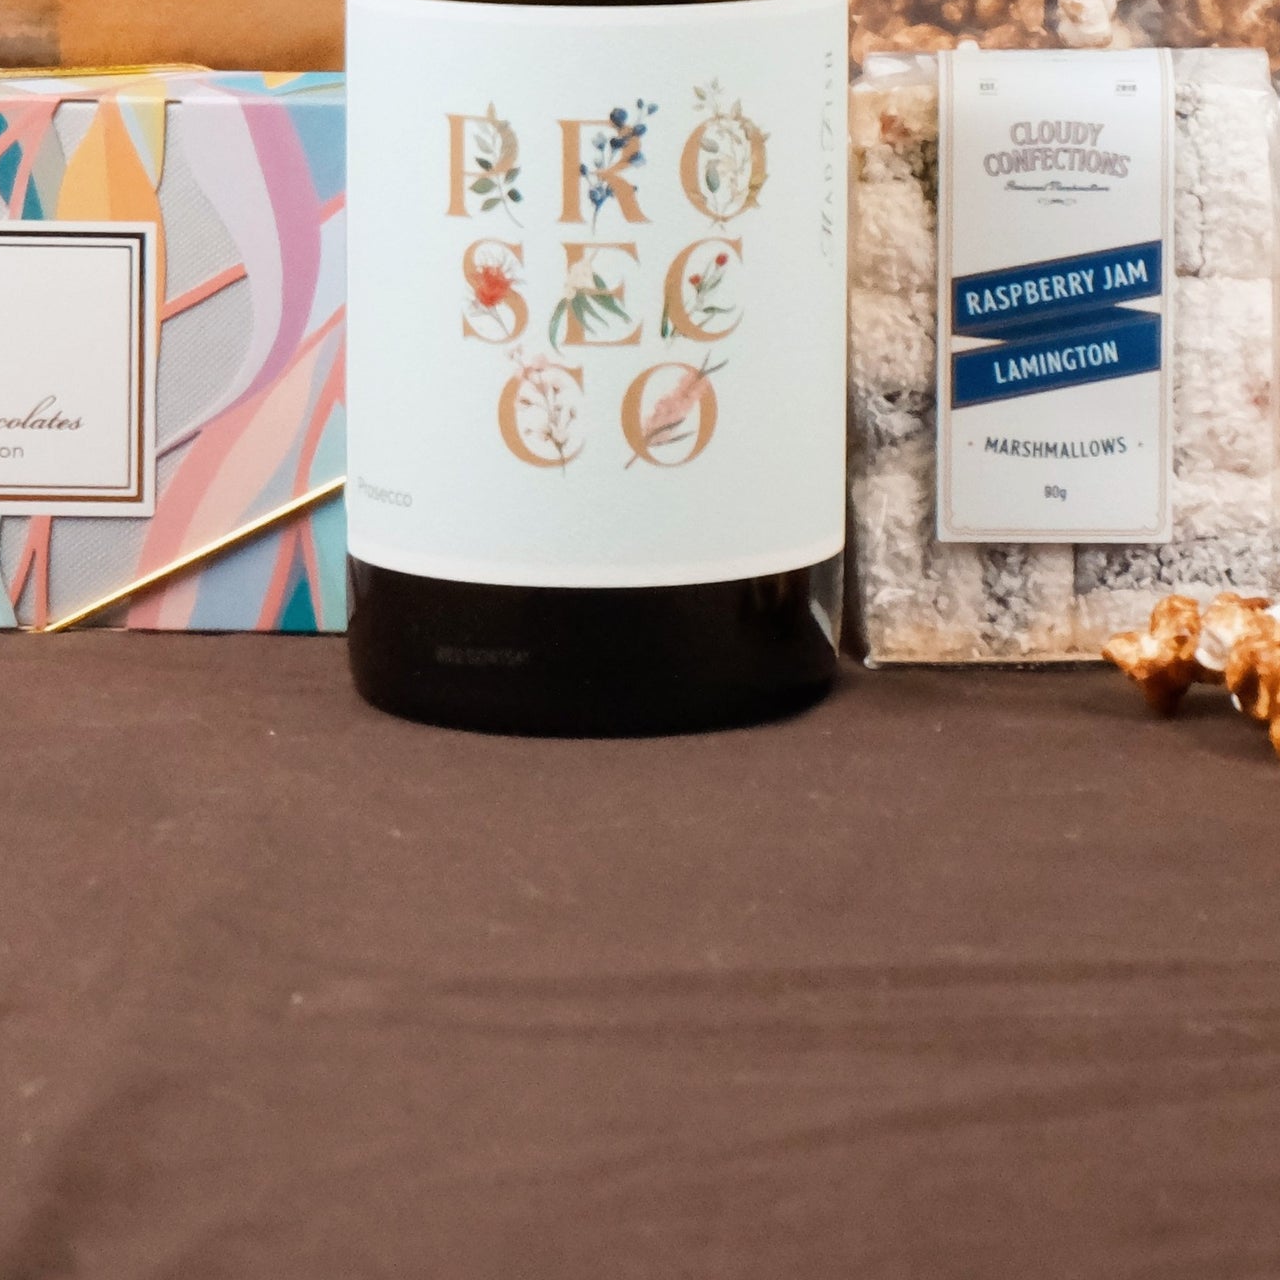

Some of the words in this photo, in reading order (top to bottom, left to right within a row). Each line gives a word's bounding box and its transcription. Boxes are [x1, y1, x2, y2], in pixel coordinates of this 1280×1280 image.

[1009, 120, 1106, 147] CLOUDY
[983, 146, 1131, 179] CONFECTIONS
[965, 270, 1095, 317] RASPBERRY
[1103, 259, 1149, 290] JAM
[993, 341, 1119, 384] LAMINGTON
[983, 436, 1128, 460] MARSHMALLOWS
